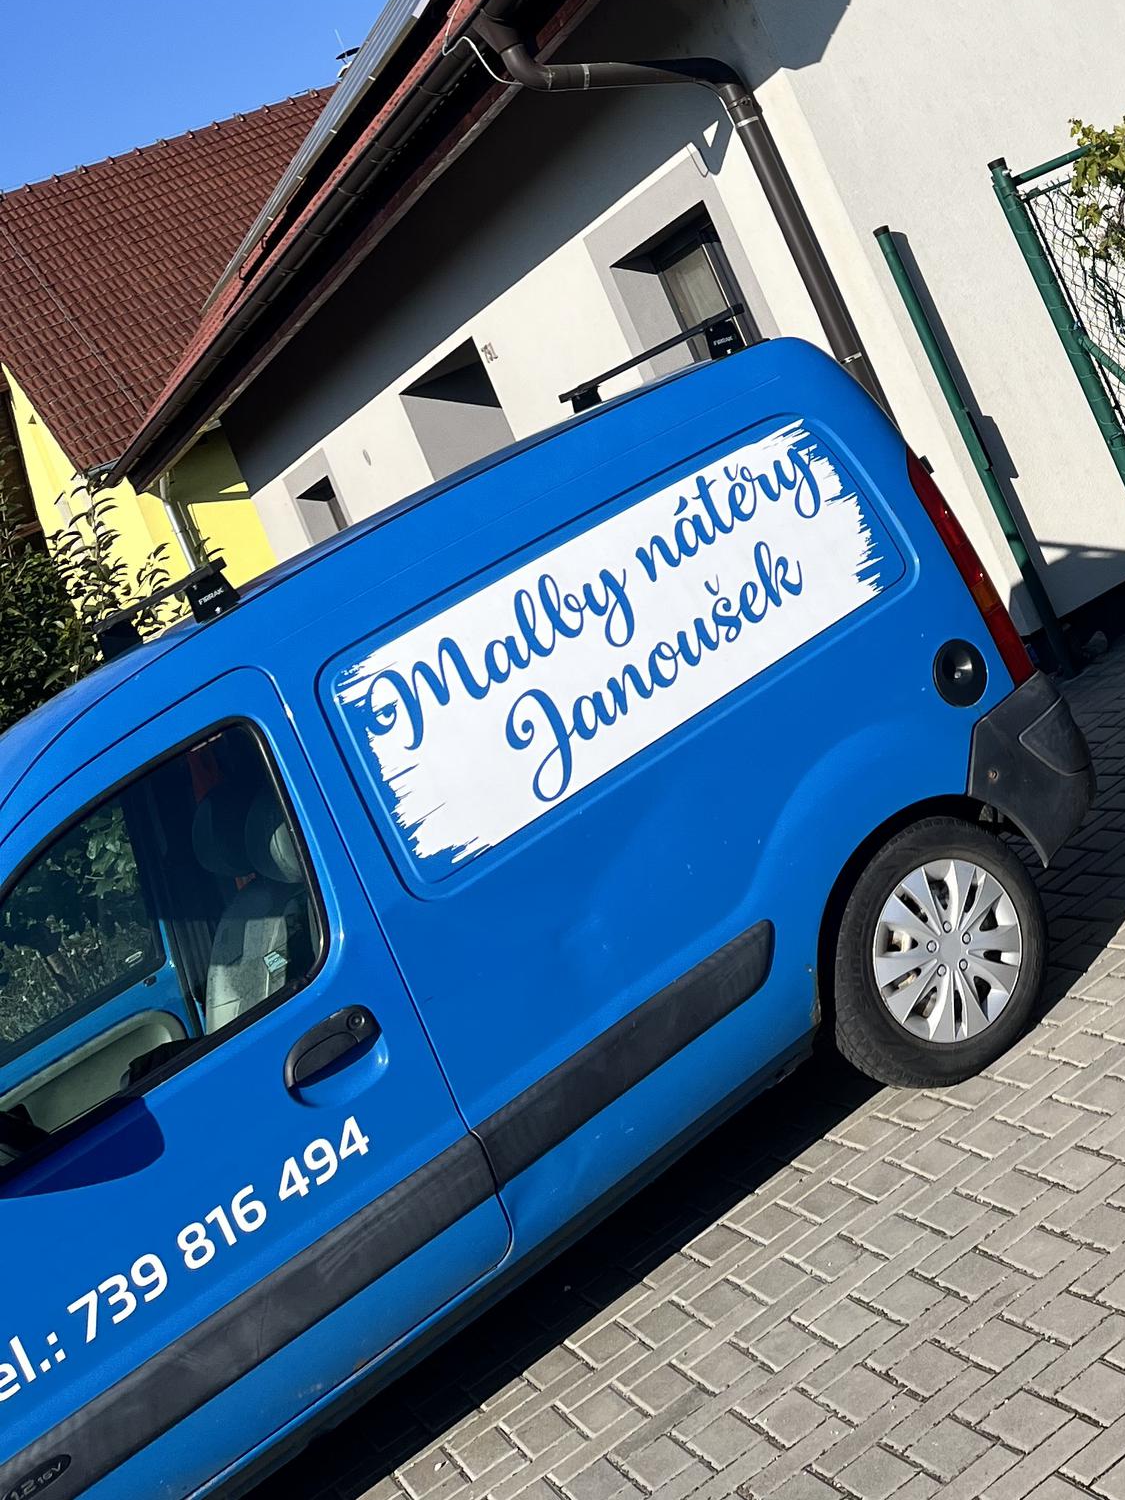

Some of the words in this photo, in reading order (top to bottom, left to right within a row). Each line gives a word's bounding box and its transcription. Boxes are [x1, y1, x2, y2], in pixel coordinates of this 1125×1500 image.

[366, 567, 635, 751] Malby
[635, 447, 821, 582] nátěry
[505, 541, 803, 802] Janoušek
[66, 1253, 168, 1343] 739
[176, 1184, 267, 1270] 816
[277, 1115, 370, 1202] 494
